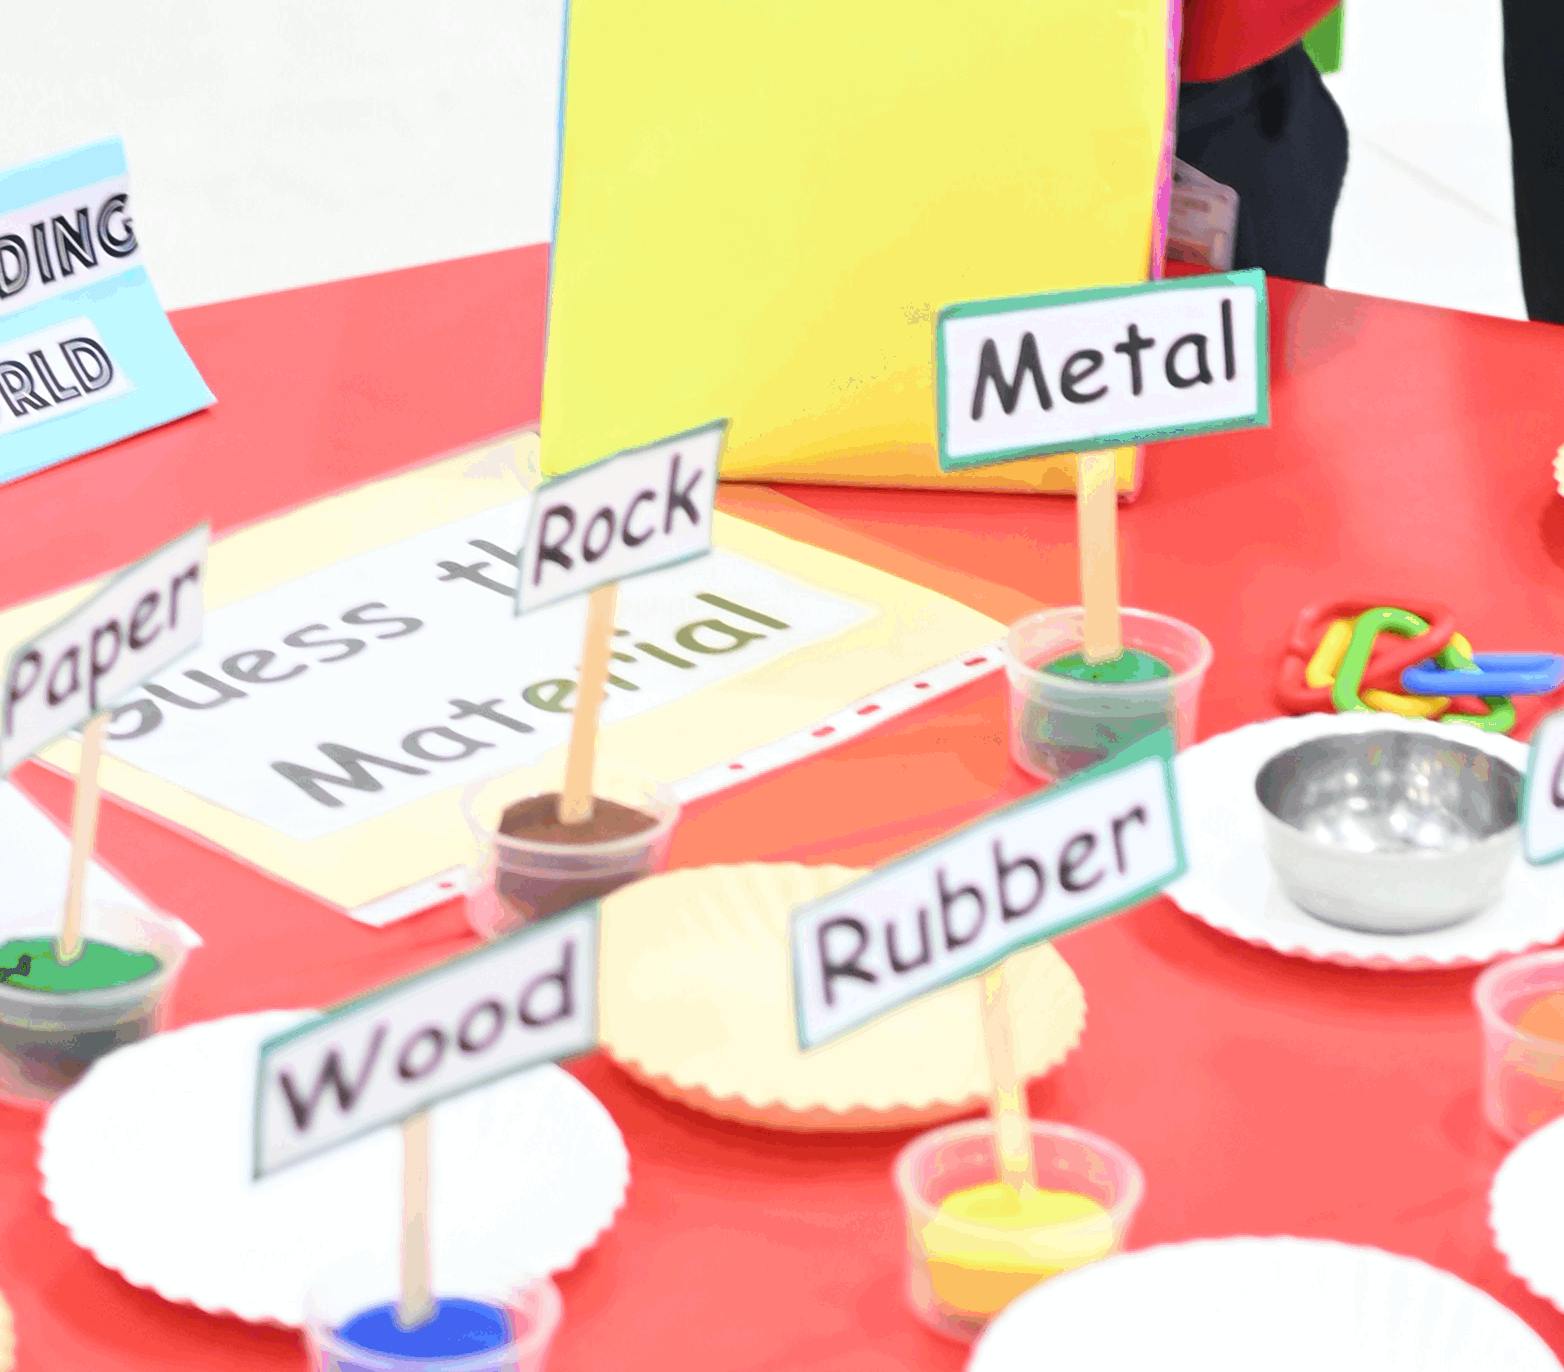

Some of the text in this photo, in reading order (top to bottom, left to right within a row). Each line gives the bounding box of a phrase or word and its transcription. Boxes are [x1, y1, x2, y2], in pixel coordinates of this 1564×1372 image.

[971, 298, 1236, 421] Metal
[532, 452, 703, 587] Rock
[3, 561, 199, 737] Paper
[270, 591, 792, 809] Material
[816, 805, 1148, 1008] Rubber
[278, 937, 577, 1134] Wood
